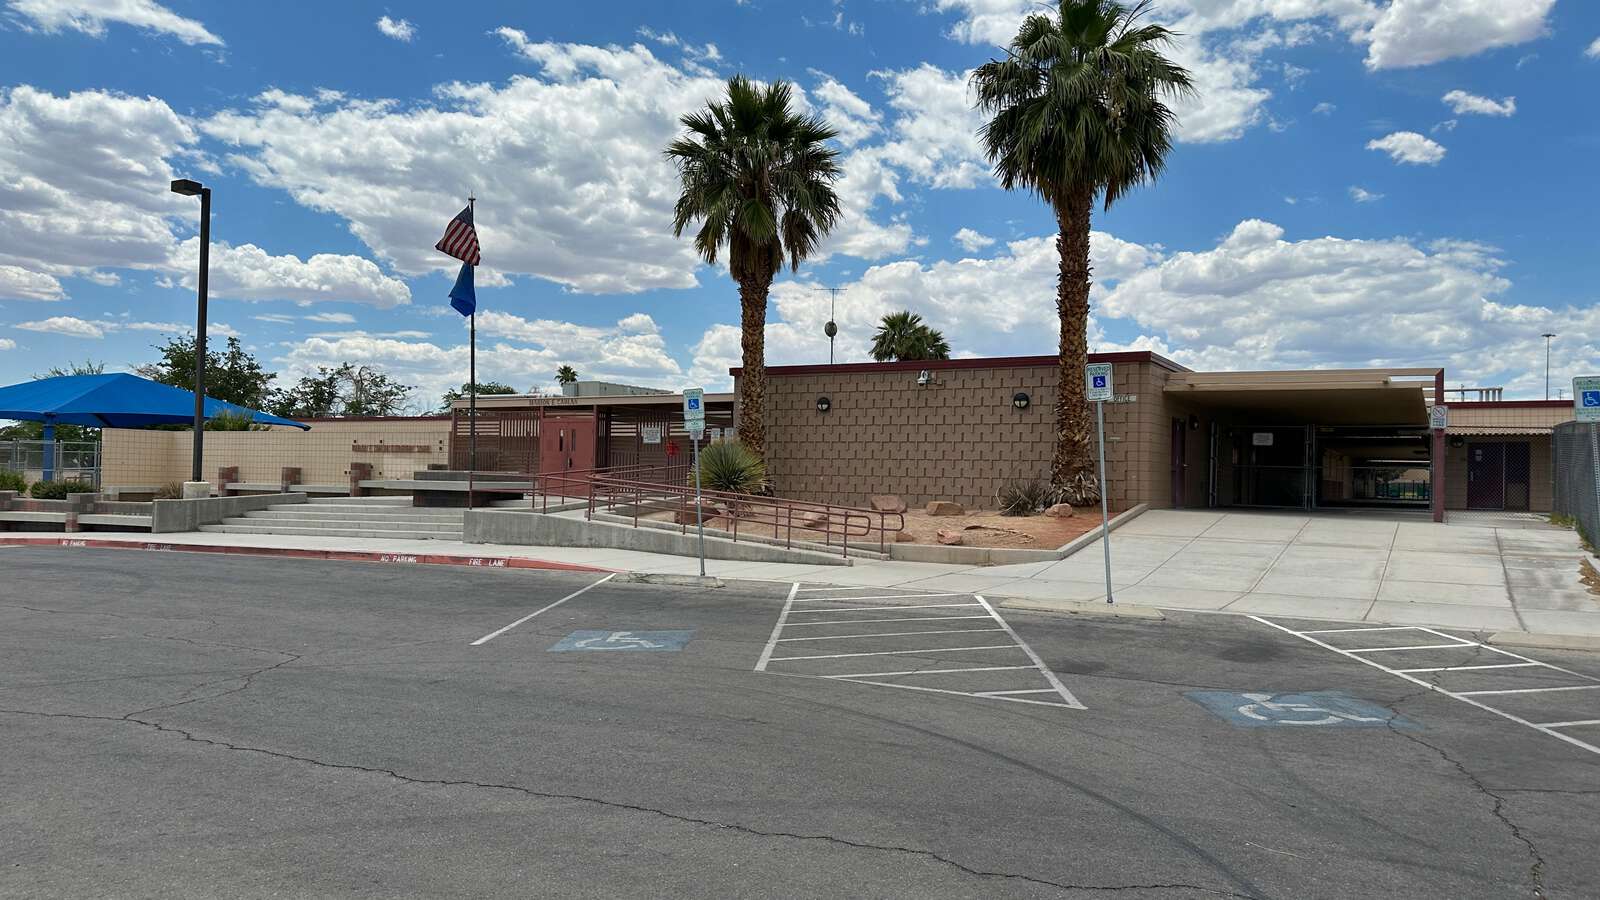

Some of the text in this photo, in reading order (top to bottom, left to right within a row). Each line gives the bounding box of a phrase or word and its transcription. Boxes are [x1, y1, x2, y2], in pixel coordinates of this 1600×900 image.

[380, 554, 417, 563] NO PARKING
[468, 558, 482, 566] FIRE
